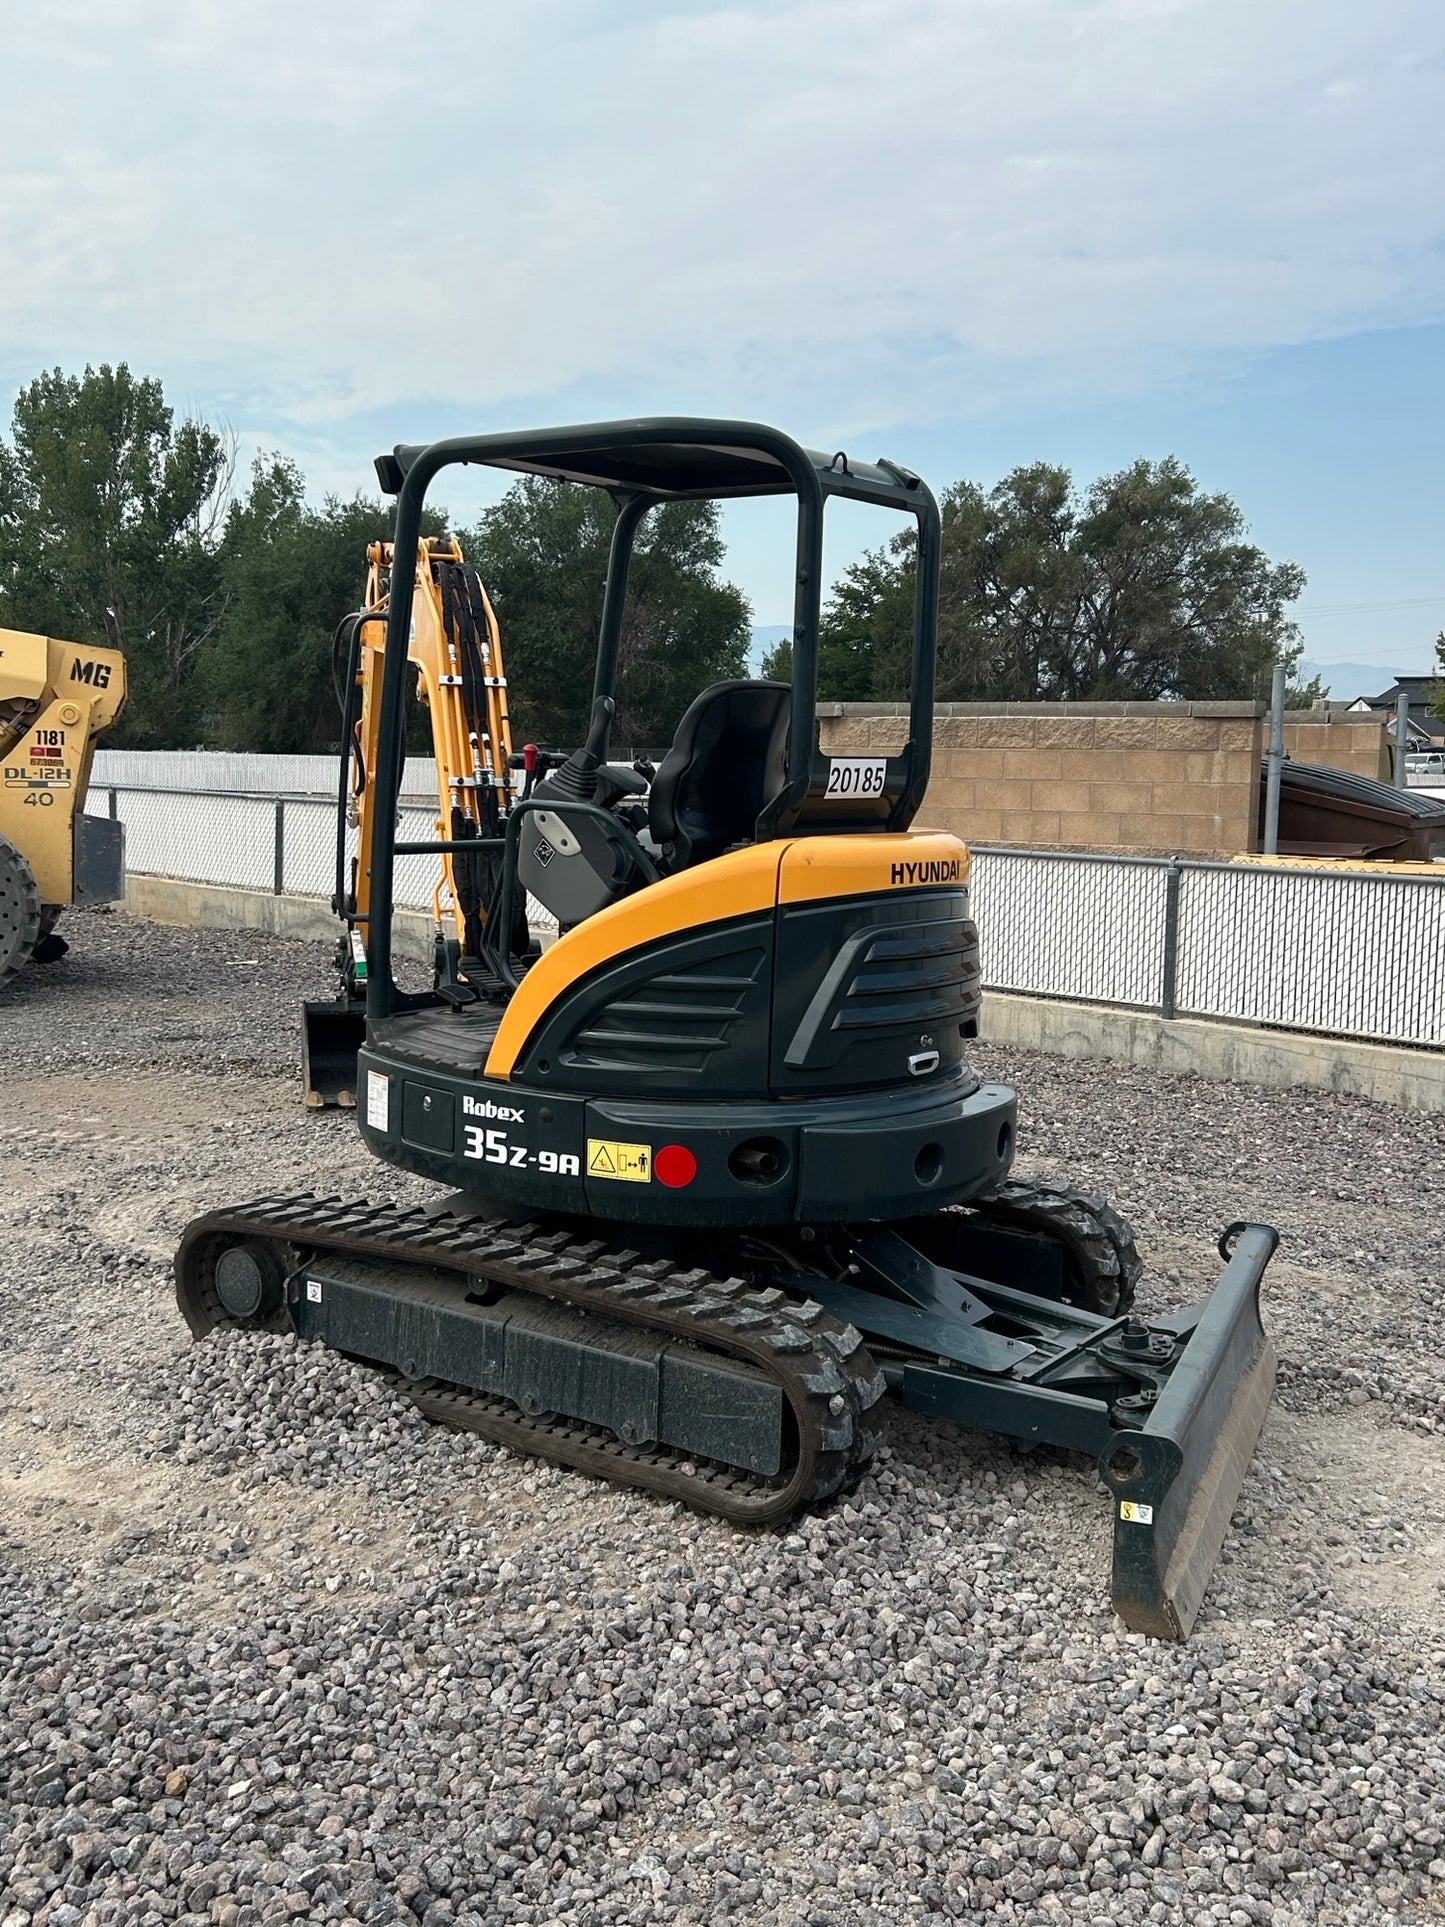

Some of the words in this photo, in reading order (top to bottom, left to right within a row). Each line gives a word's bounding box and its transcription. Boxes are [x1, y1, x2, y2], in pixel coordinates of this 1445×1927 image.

[70, 657, 112, 689] MG
[35, 730, 65, 746] 1181
[4, 767, 71, 780] DL-12H
[828, 767, 884, 793] 20185
[23, 792, 54, 806] 40
[891, 860, 960, 884] HYUNDAI
[462, 1095, 525, 1124] Robex
